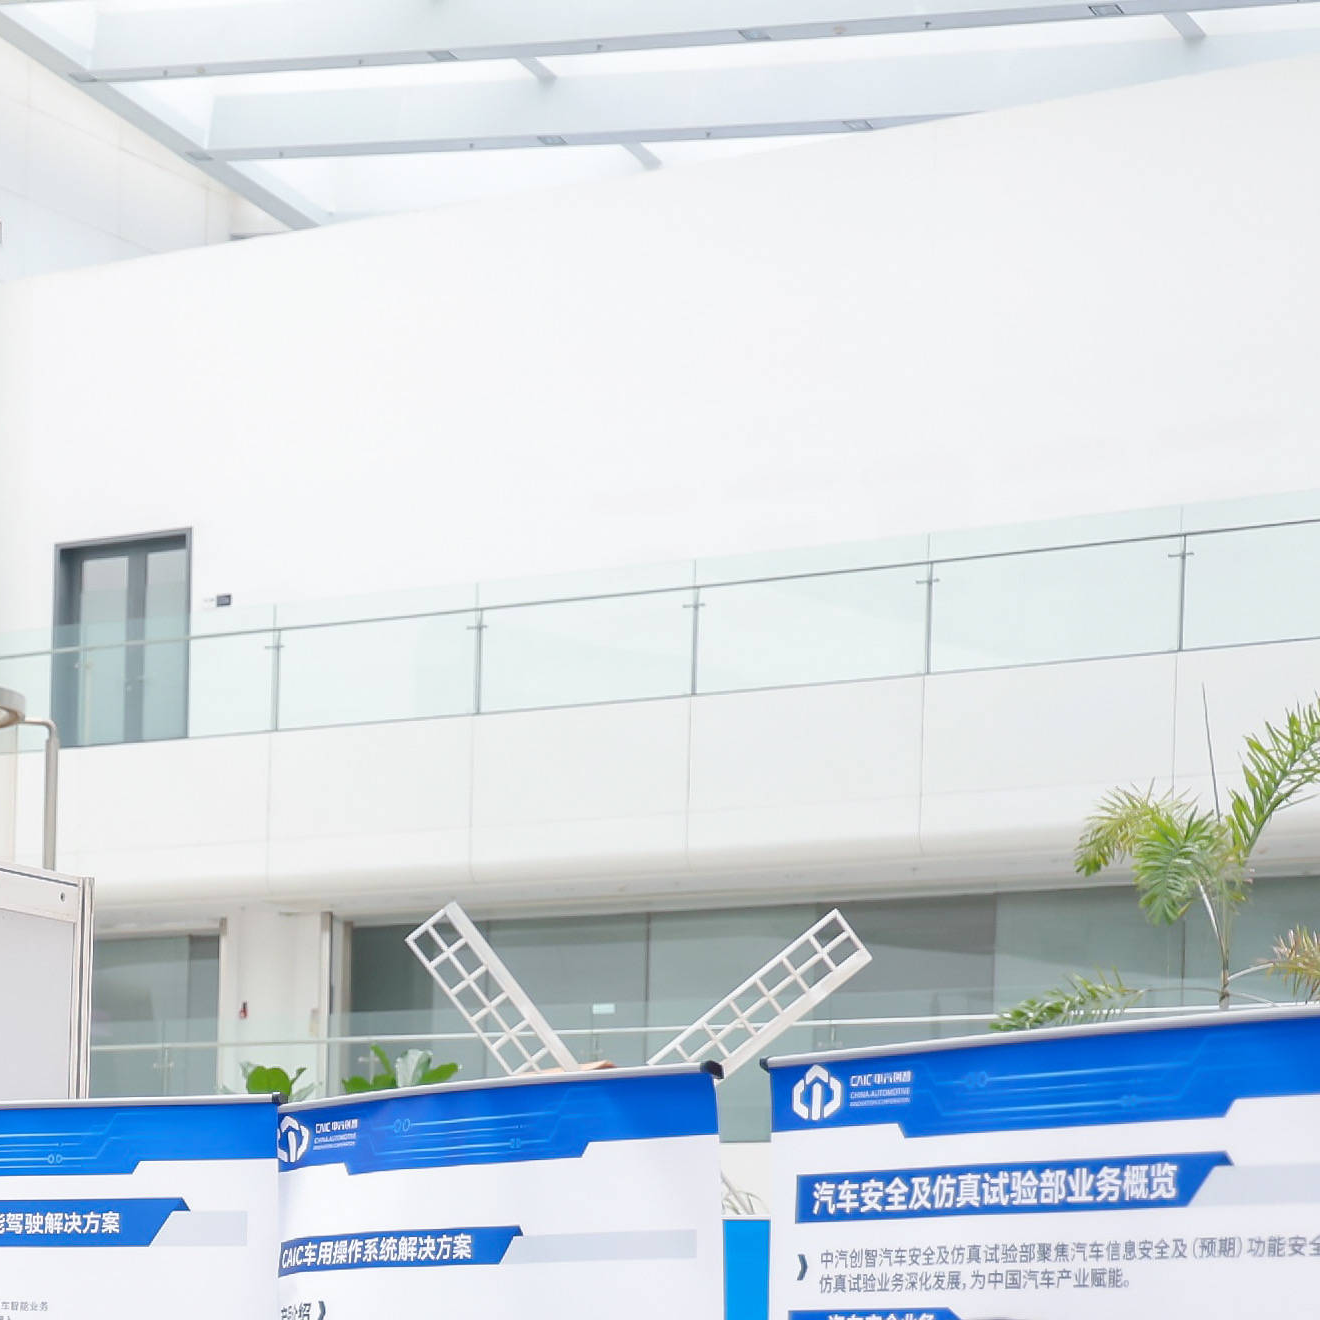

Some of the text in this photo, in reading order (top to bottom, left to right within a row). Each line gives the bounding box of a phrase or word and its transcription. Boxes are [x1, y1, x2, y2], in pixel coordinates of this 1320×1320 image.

[812, 1161, 1178, 1215] 汽车安全及仿真试验部业务概览
[281, 1233, 472, 1269] CAIC车用操作系统解决方案
